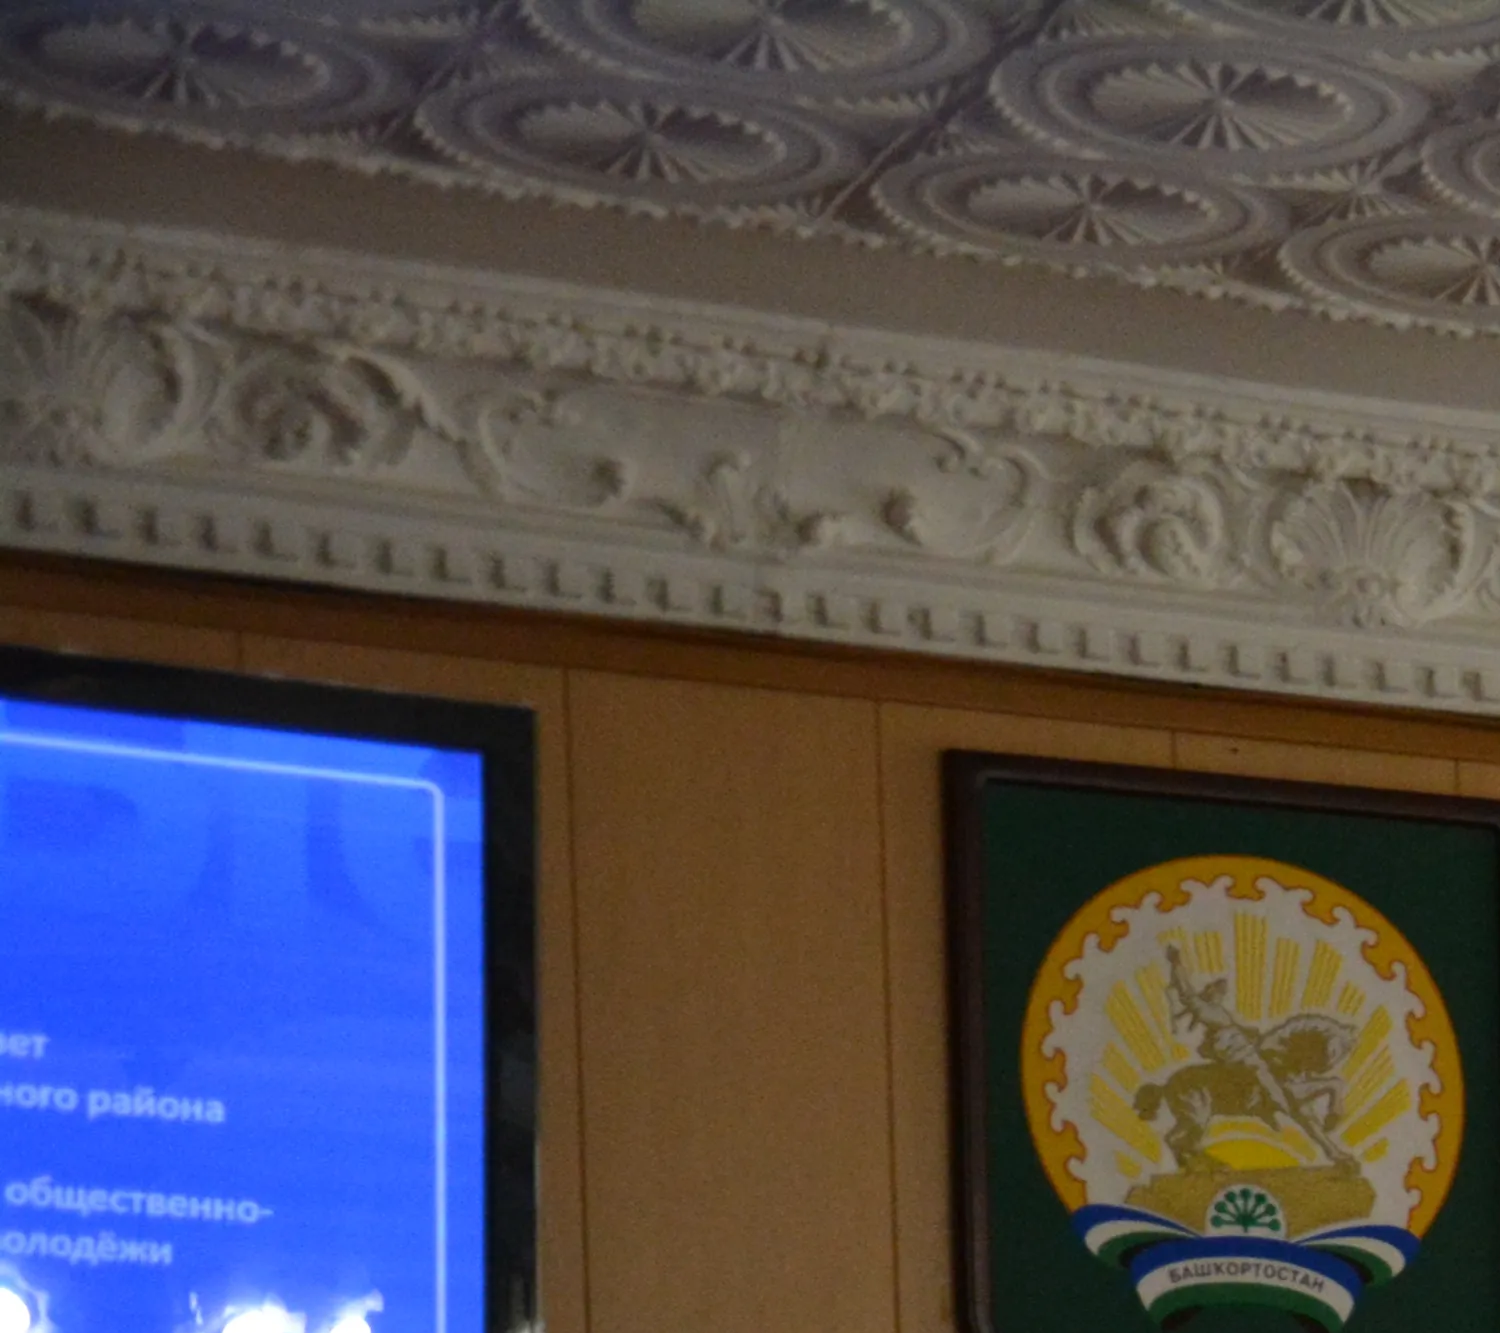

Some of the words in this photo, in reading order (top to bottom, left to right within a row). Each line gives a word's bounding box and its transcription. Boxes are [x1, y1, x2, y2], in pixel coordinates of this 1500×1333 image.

[88, 1086, 226, 1123] района
[5, 1176, 274, 1223] общественно-
[1168, 1261, 1325, 1293] БАШКОРТОСТАН
